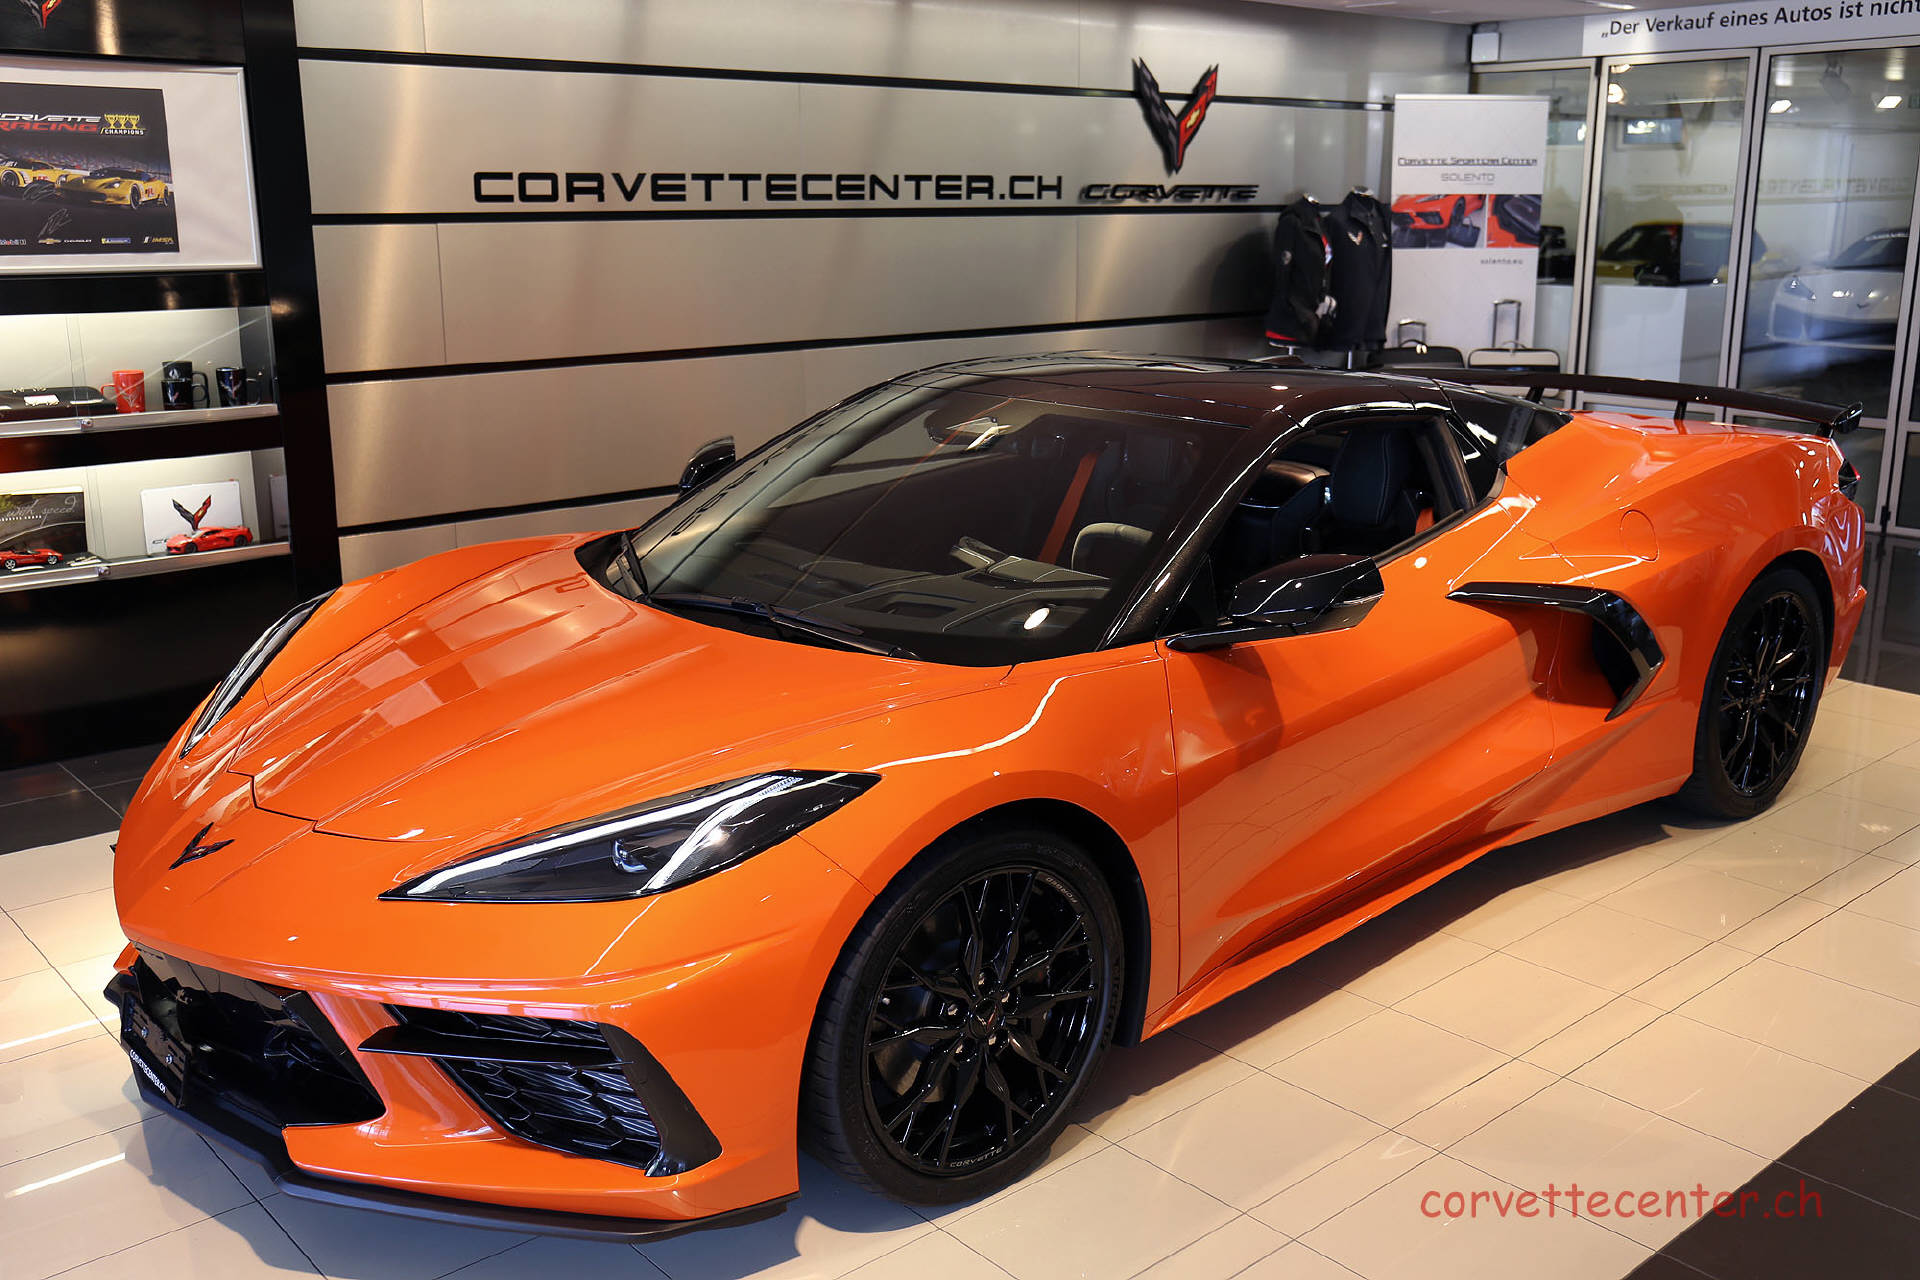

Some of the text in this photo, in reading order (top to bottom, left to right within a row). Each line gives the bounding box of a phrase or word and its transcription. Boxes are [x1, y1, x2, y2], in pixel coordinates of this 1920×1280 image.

[1601, 20, 1639, 38] „Der
[1645, 11, 1715, 32] Verkauf
[1719, 10, 1768, 27] eines
[1774, 5, 1832, 24] Autos
[1839, 1, 1864, 19] ist
[0, 112, 102, 123] ORVETTE
[1440, 172, 1496, 182] SOLENTO
[473, 171, 1063, 203] CORVETTECENTER.CH
[1083, 184, 1260, 201] CORVETTE
